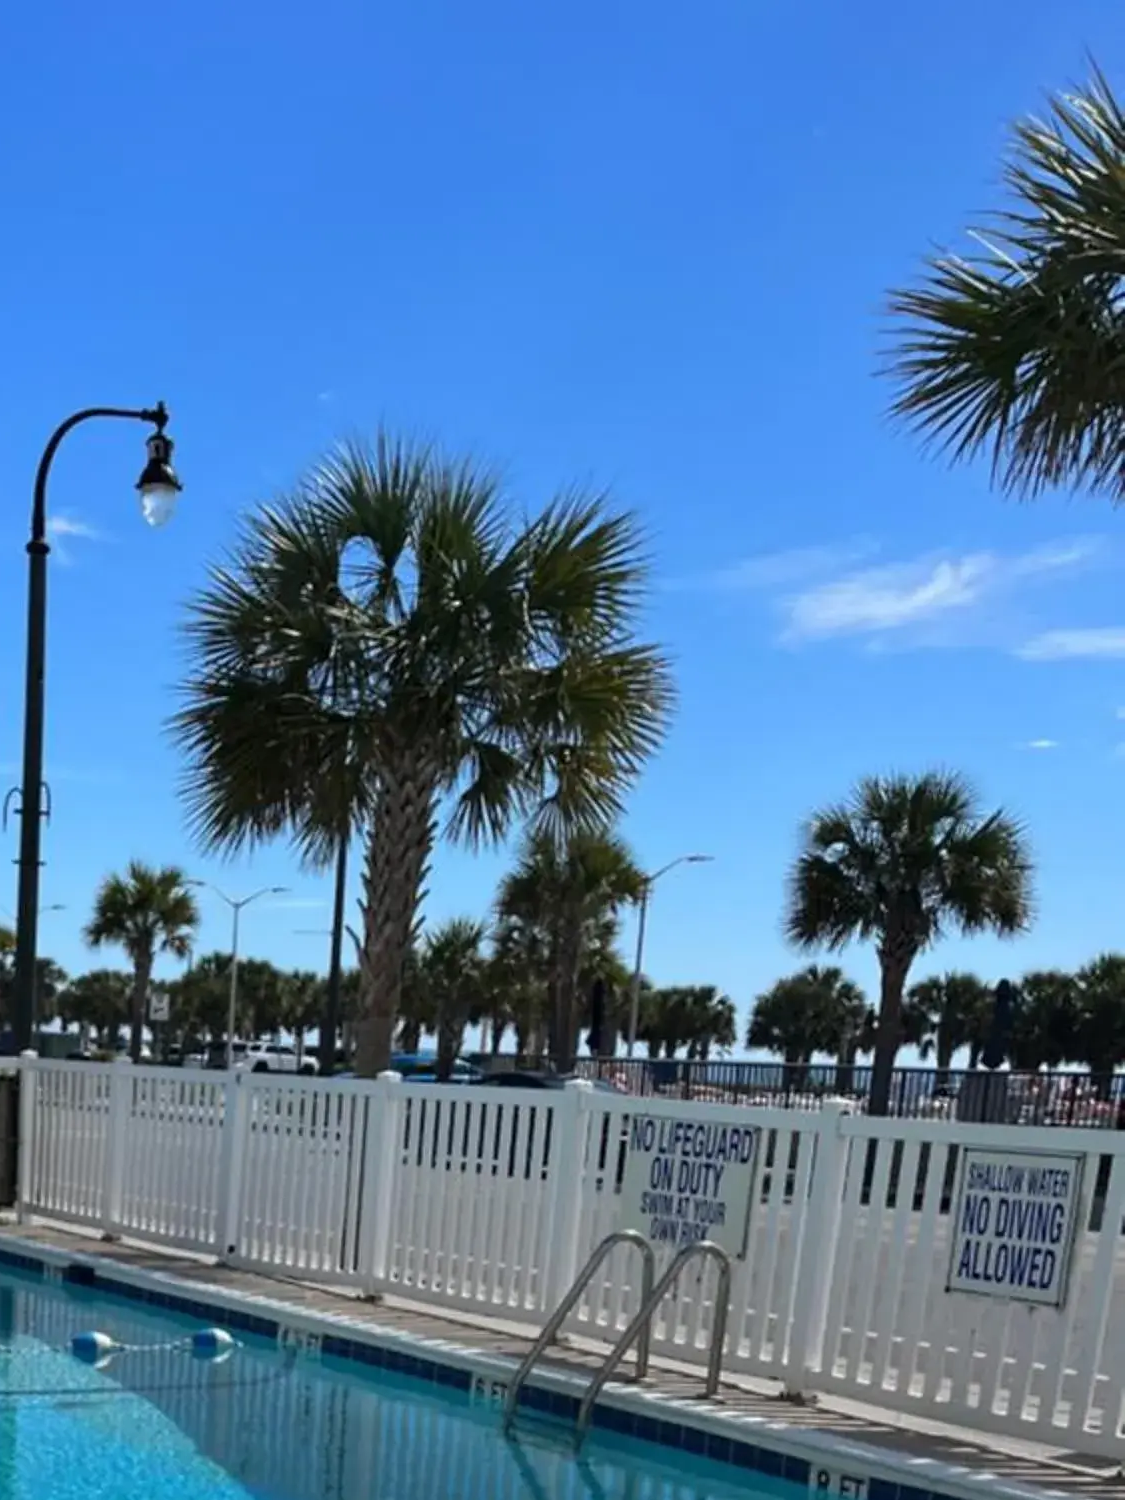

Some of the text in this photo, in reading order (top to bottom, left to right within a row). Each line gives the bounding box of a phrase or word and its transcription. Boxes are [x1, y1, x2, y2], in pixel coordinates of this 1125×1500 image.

[631, 1117, 754, 1164] NO LIFEGUARD
[650, 1156, 725, 1198] ON DUTY
[967, 1162, 1070, 1198] SHALLOW WATER
[962, 1194, 1065, 1244] NO DIVING
[957, 1238, 1057, 1291] ALLOWED
[839, 1474, 866, 1500] FT
